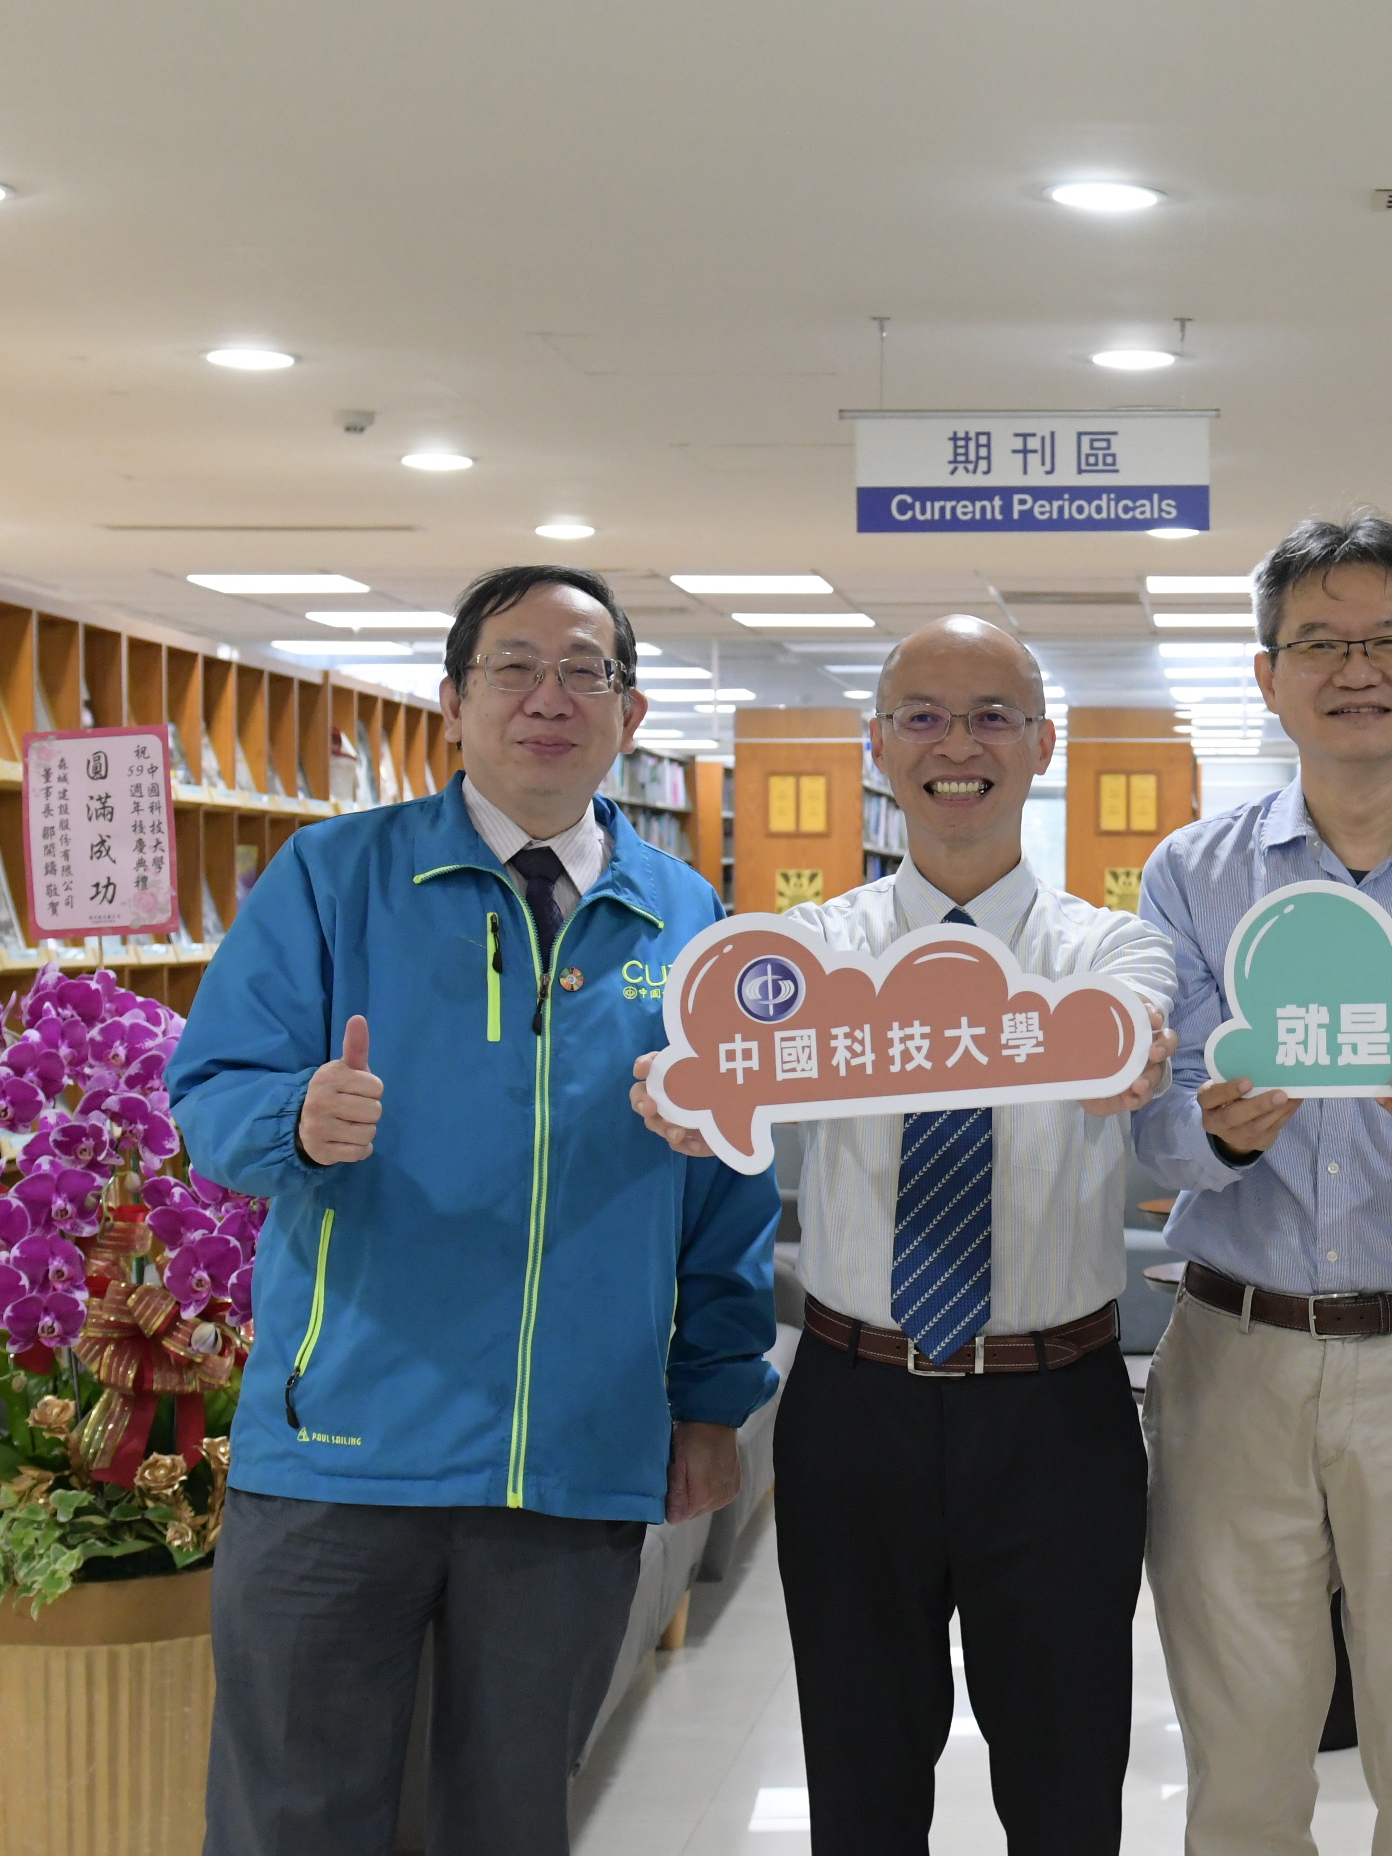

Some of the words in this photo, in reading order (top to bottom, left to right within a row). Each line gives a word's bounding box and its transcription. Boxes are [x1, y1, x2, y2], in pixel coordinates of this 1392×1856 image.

[947, 430, 1120, 476] 期刊區
[890, 493, 1003, 521] Current
[1011, 492, 1178, 520] Periodicals
[134, 744, 150, 760] 祝
[85, 750, 117, 906] 圓滿成功
[127, 764, 150, 891] 59週年校慶典禮
[146, 763, 166, 874] 中國科技大學
[621, 959, 673, 987] CU
[717, 1010, 1046, 1086] 中國科技大學
[1275, 1003, 1392, 1067] 就是
[312, 1432, 330, 1444] PAUL
[331, 1435, 362, 1446] SAILING
